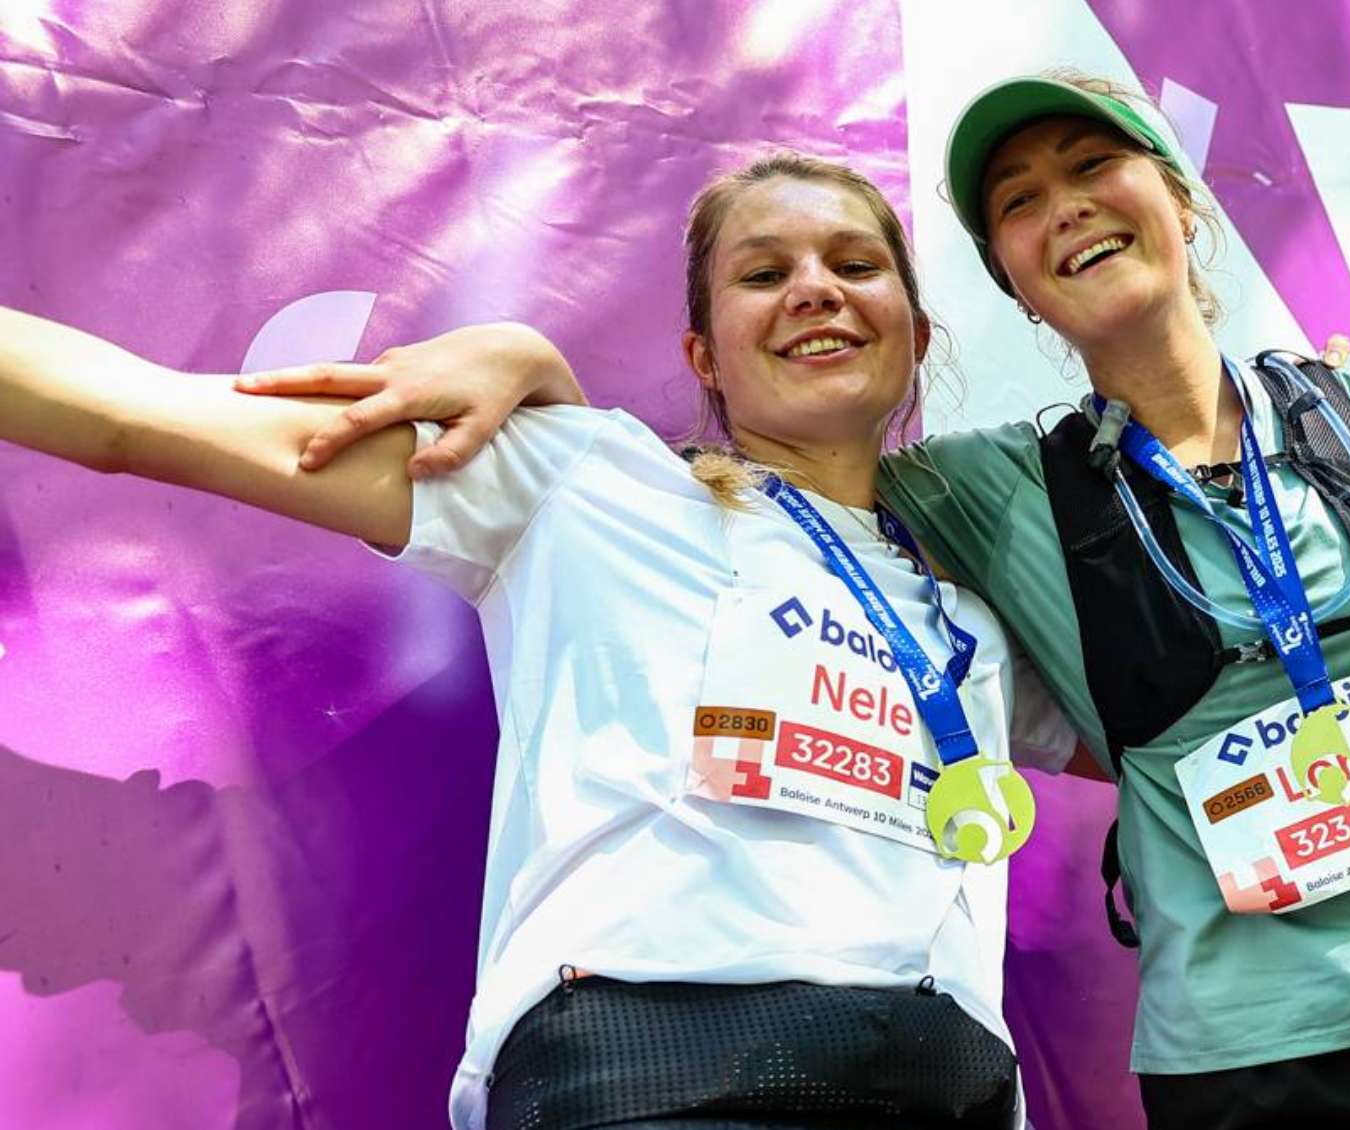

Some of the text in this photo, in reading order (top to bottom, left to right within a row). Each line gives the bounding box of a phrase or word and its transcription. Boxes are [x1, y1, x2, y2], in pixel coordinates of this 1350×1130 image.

[1270, 551, 1288, 578] 2025
[820, 608, 900, 674] balo
[811, 663, 914, 737] Nele
[791, 732, 892, 787] 32283
[780, 787, 821, 805] Baloise
[825, 798, 870, 820] Antwerp
[873, 810, 887, 824] 10
[889, 815, 913, 833] Miles
[1306, 870, 1345, 892] Baloise
